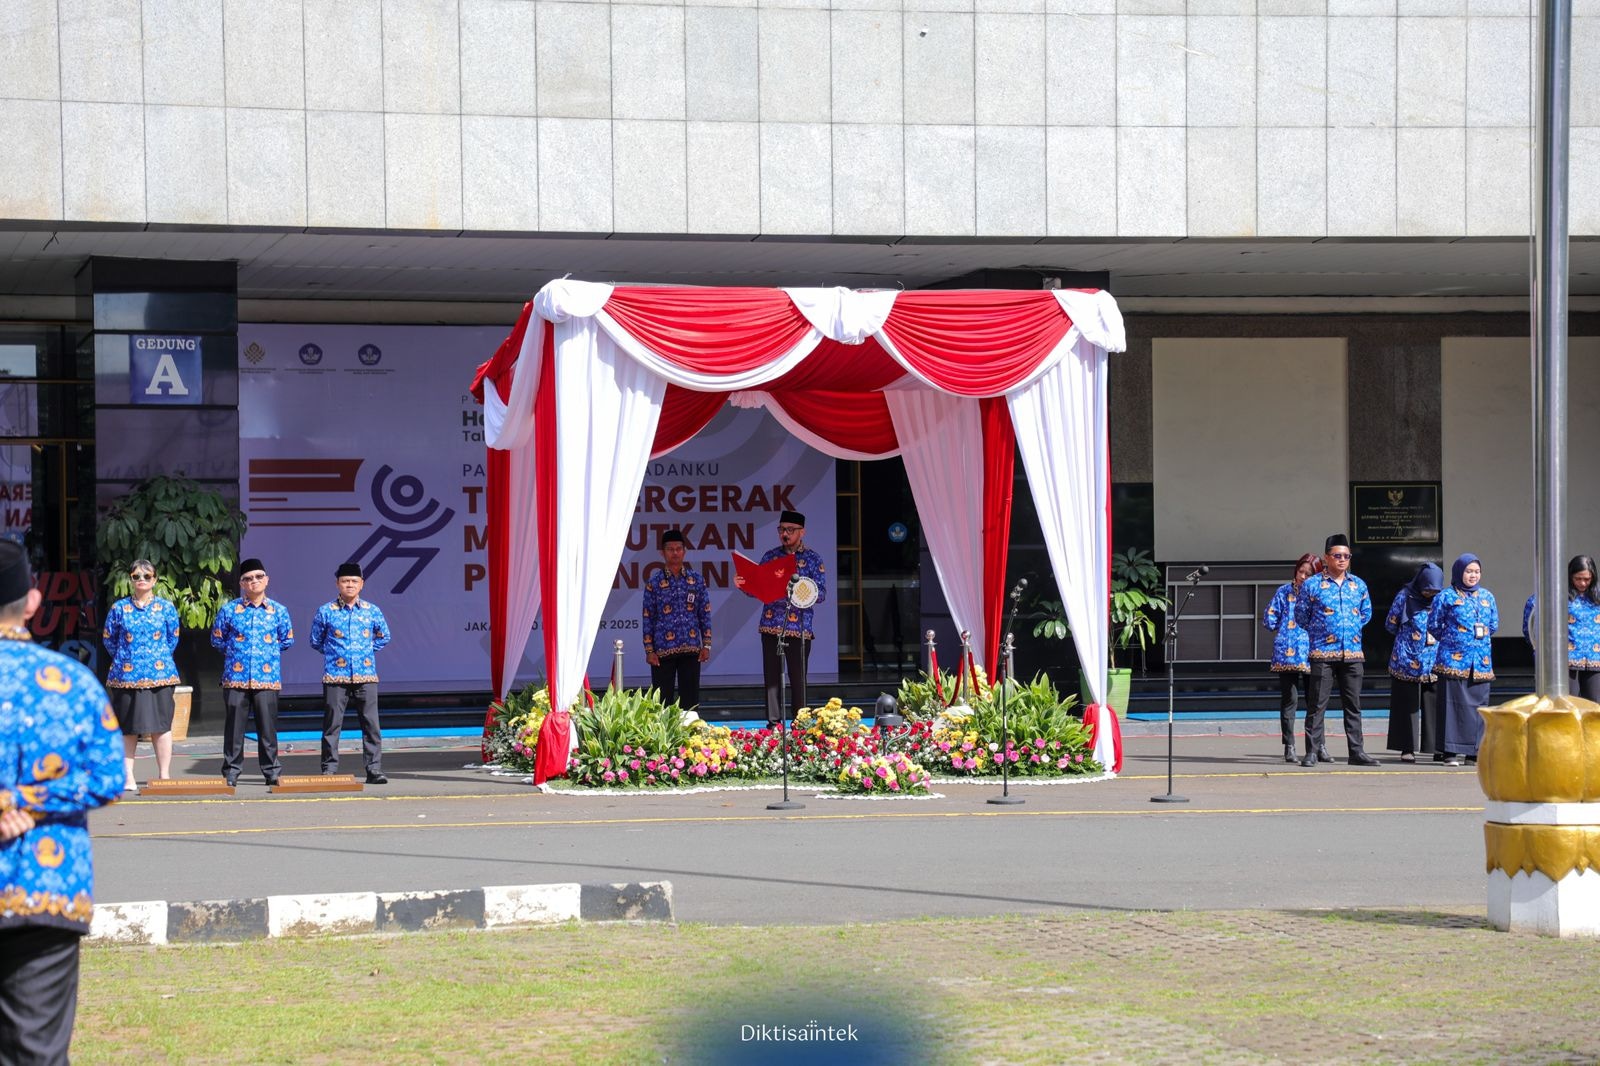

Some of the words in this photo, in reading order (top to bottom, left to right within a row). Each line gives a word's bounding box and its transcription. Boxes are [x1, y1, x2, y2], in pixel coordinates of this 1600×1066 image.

[136, 338, 196, 351] GEDUNG
[145, 353, 189, 395] A
[610, 619, 639, 630] 2025
